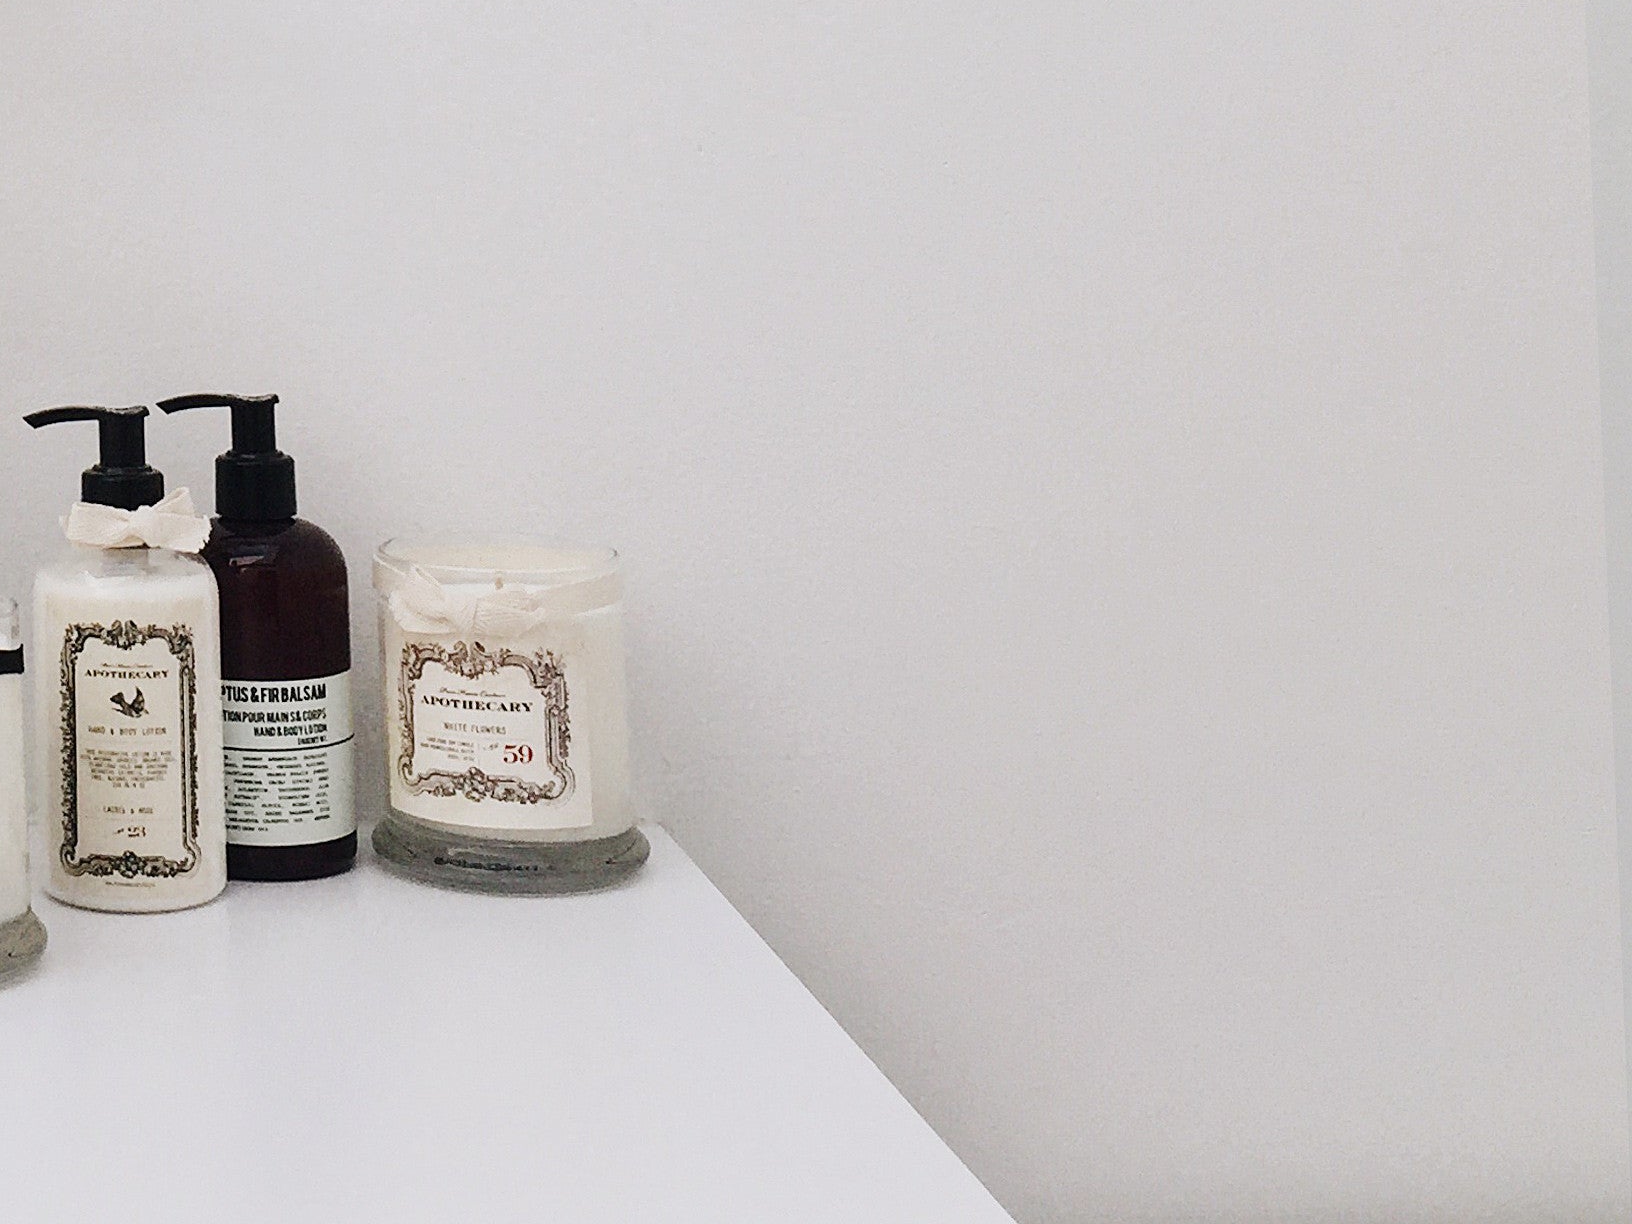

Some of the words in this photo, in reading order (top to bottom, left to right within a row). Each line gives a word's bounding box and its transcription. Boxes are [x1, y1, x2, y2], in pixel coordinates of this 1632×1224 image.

[84, 669, 168, 680] APOTHECARY
[250, 686, 260, 703] &
[261, 687, 279, 703] FIR
[281, 683, 327, 702] BALSAM
[421, 695, 533, 713] APOTHECARY
[254, 726, 276, 737] HAND
[284, 725, 304, 737] BODY
[503, 744, 534, 765] 59
